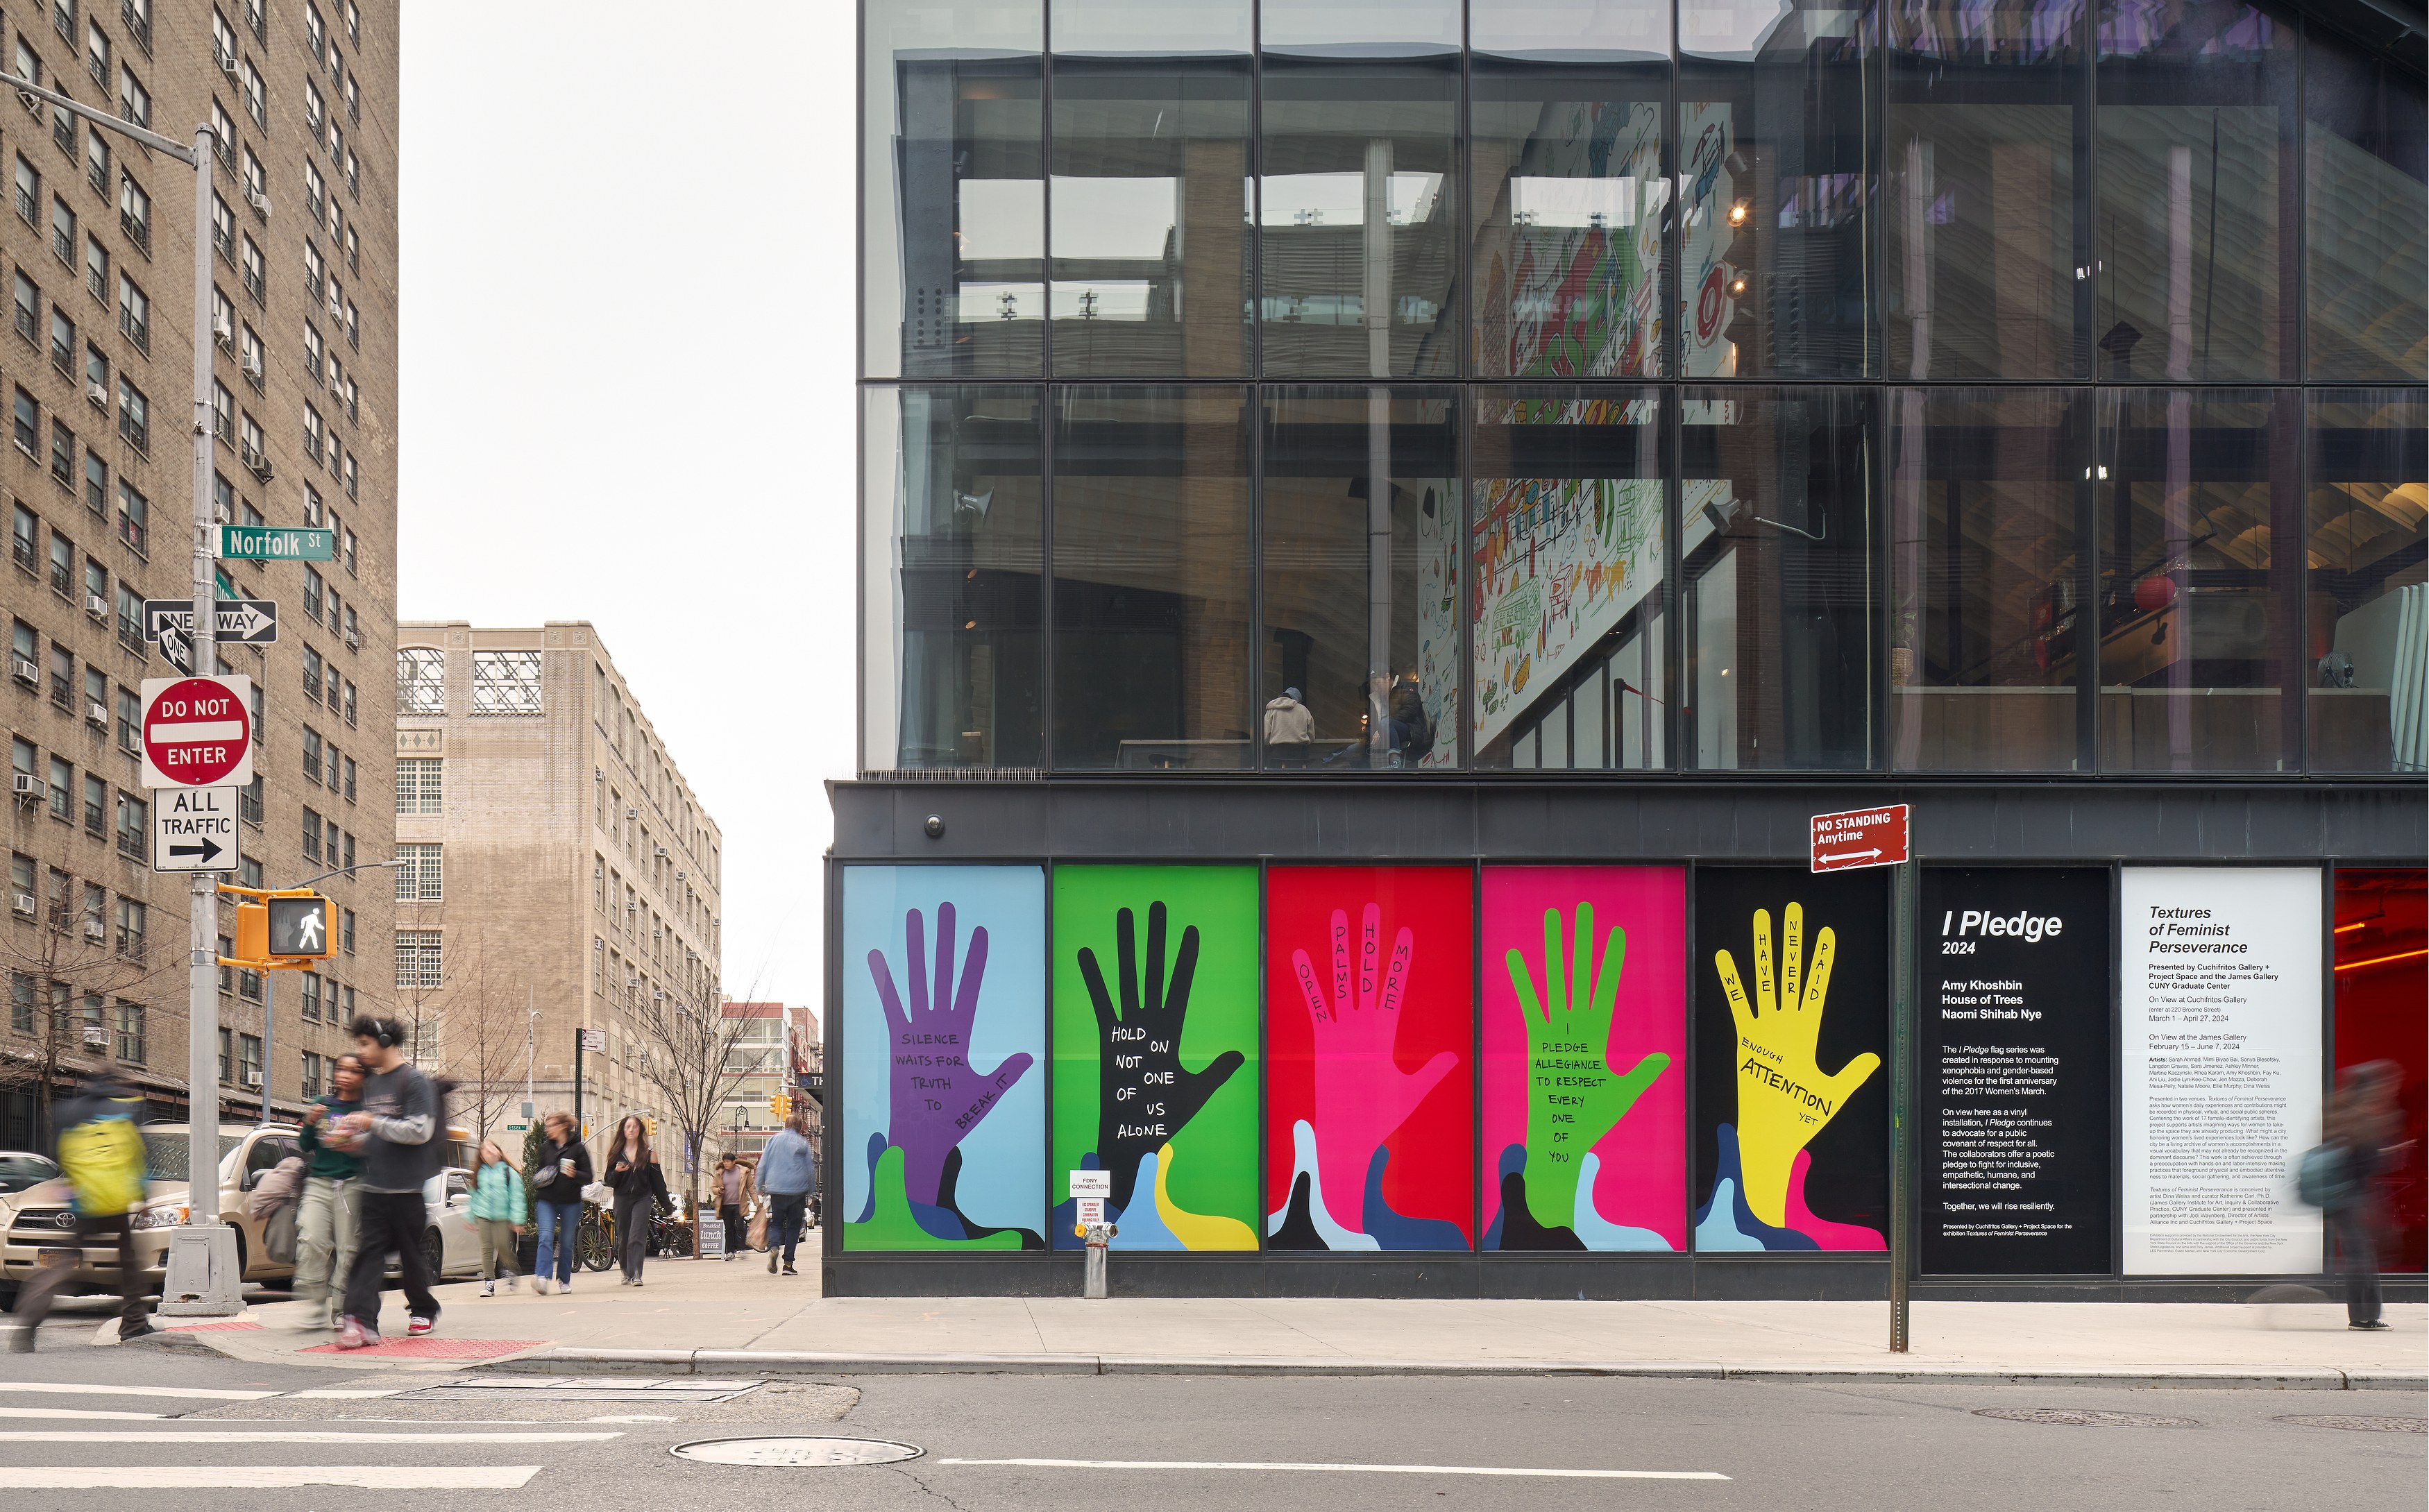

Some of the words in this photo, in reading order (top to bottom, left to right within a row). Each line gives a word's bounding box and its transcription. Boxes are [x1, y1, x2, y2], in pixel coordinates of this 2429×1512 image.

[231, 530, 300, 555] Norfolk
[308, 532, 321, 547] St
[218, 613, 259, 629] WAY
[1502, 626, 1512, 646] NYC
[167, 634, 185, 662] ONE
[162, 701, 187, 717] DO
[195, 699, 229, 715] NOT
[168, 747, 226, 765] ENTER
[174, 792, 219, 812] ALL
[162, 817, 230, 834] TRAFFIC
[1817, 820, 1833, 832] NO
[1836, 813, 1891, 830] STANDING
[1818, 831, 1863, 845] Anytime
[2151, 906, 2211, 918] Textures
[1943, 911, 1956, 935] I
[1956, 911, 2062, 943] Pledge
[2149, 924, 2165, 935] of
[2167, 924, 2230, 935] Feminist
[1942, 942, 1975, 954] 2024
[2149, 941, 2247, 953] Perseverance
[1336, 927, 1347, 999] PALMS
[1363, 923, 1376, 993] HOLD
[1759, 934, 1770, 992] HAVE
[1788, 921, 1798, 994] NEVER
[1385, 945, 1408, 1010] MORE
[1810, 943, 1828, 1000] PAID
[1725, 974, 1743, 1001] WE
[1942, 980, 1967, 992] Amy
[1970, 980, 2022, 989] Khoshbin
[1300, 964, 1327, 1023] OPEN
[1943, 995, 1977, 1004] House
[1980, 994, 1991, 1004] of
[1993, 995, 2023, 1004] Trees
[1943, 1009, 1977, 1019] Naomi
[1980, 1009, 2017, 1019] Shihab
[2021, 1009, 2042, 1021] Nye
[1111, 1026, 1146, 1042] HOLD
[1567, 1023, 1568, 1035] I
[902, 1033, 959, 1045] SILENCE
[1150, 1040, 1169, 1054] ON
[1543, 1043, 1588, 1053] PLEDGE
[1741, 1037, 1784, 1064] ENOUGH
[1963, 1046, 1989, 1055] Pledge
[1990, 1046, 2004, 1055] flag
[896, 1055, 933, 1067] WAITS
[936, 1056, 965, 1067] FOR
[1115, 1055, 1142, 1069] NOT
[1536, 1058, 1602, 1069] ALLEGIANCE
[2025, 1056, 2058, 1065] mounting
[1144, 1071, 1174, 1085] ONE
[1943, 1067, 1985, 1076] xenophobia
[2003, 1067, 2053, 1076] gender-based
[911, 1077, 951, 1090] TRUTH
[1536, 1077, 1550, 1086] TO
[1557, 1077, 1606, 1087] RESPECT
[1741, 1057, 1832, 1116] ATTENTION
[2015, 1077, 2057, 1086] anniversary
[1117, 1087, 1137, 1101] OF
[1548, 1095, 1584, 1107] EVERY
[924, 1099, 942, 1110] TO
[954, 1091, 996, 1130] BREAK
[995, 1073, 1007, 1090] IT
[1146, 1103, 1165, 1116] US
[1552, 1114, 1575, 1123] ONE
[1800, 1112, 1818, 1125] YET
[1117, 1123, 1167, 1139] ALONE
[1554, 1132, 1568, 1142] OF
[1549, 1151, 1568, 1162] YOU
[1943, 1203, 1977, 1212] Together,
[2020, 1203, 2054, 1211] resiliently.
[700, 1230, 722, 1240] lunch
